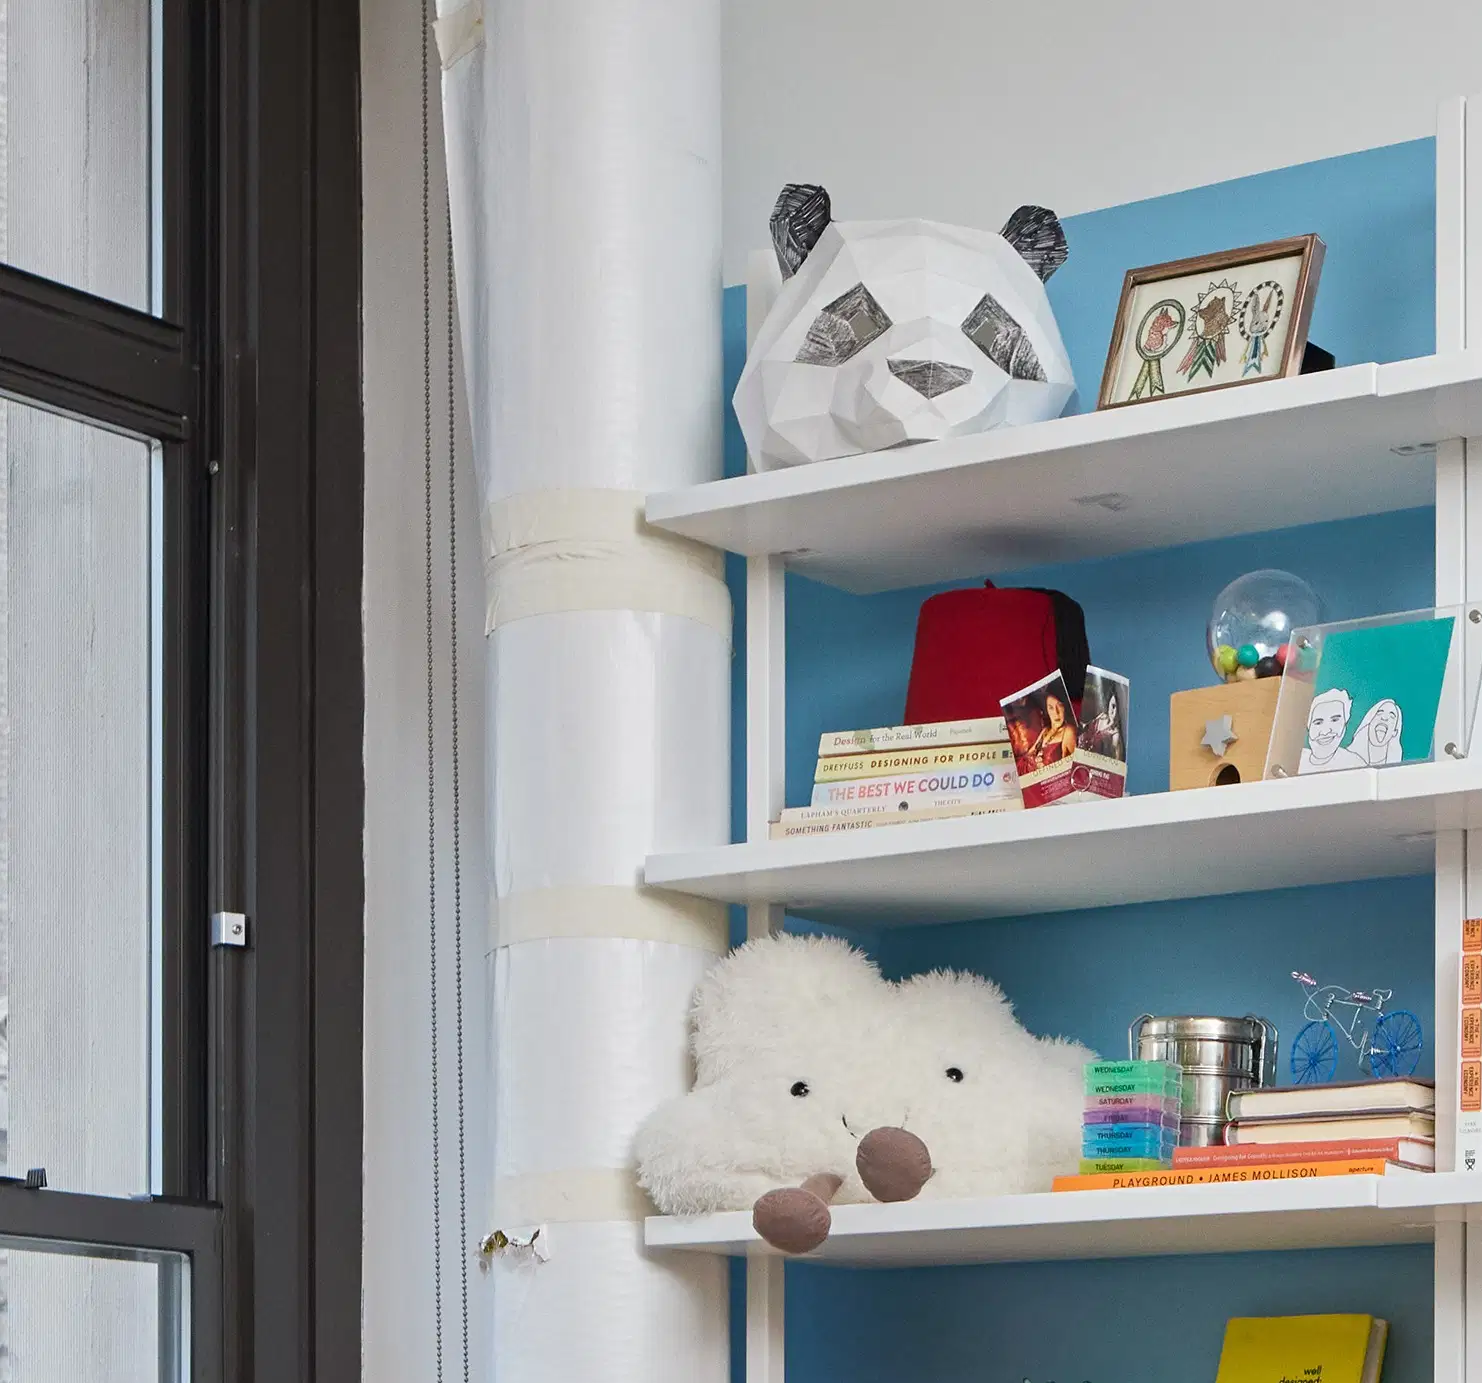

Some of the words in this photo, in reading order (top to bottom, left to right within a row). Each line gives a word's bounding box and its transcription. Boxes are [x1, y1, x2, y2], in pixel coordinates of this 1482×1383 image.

[833, 736, 866, 747] Design
[869, 733, 881, 743] for
[881, 732, 893, 741] the
[895, 731, 912, 741] Real
[914, 729, 938, 740] World
[870, 756, 929, 768] DESIGNING
[933, 754, 954, 764] FOR
[958, 750, 997, 762] PEOPLE
[823, 761, 864, 772] DREYFUSS
[827, 786, 855, 801] THE
[858, 782, 892, 798] BEST
[893, 781, 915, 795] WE
[918, 776, 968, 793] COULD
[971, 772, 996, 788] DO
[840, 805, 887, 817] QUARTERLY
[785, 824, 831, 836] SOMETHING
[831, 820, 873, 833] FANTASTIC
[1094, 1066, 1134, 1075] WEDNESDAY
[1095, 1084, 1136, 1093] WEDNESDAY
[1099, 1097, 1134, 1106] SATURDAY
[1097, 1132, 1133, 1140] THURSDAY
[1096, 1146, 1132, 1155] THURSDAY
[1095, 1163, 1124, 1171] TUESDAY
[1348, 1165, 1374, 1173] aperture
[1113, 1173, 1194, 1188] PLAYGROUND
[1208, 1171, 1248, 1184] JAMES
[1252, 1168, 1318, 1181] MOLLISON
[1304, 1366, 1322, 1376] well
